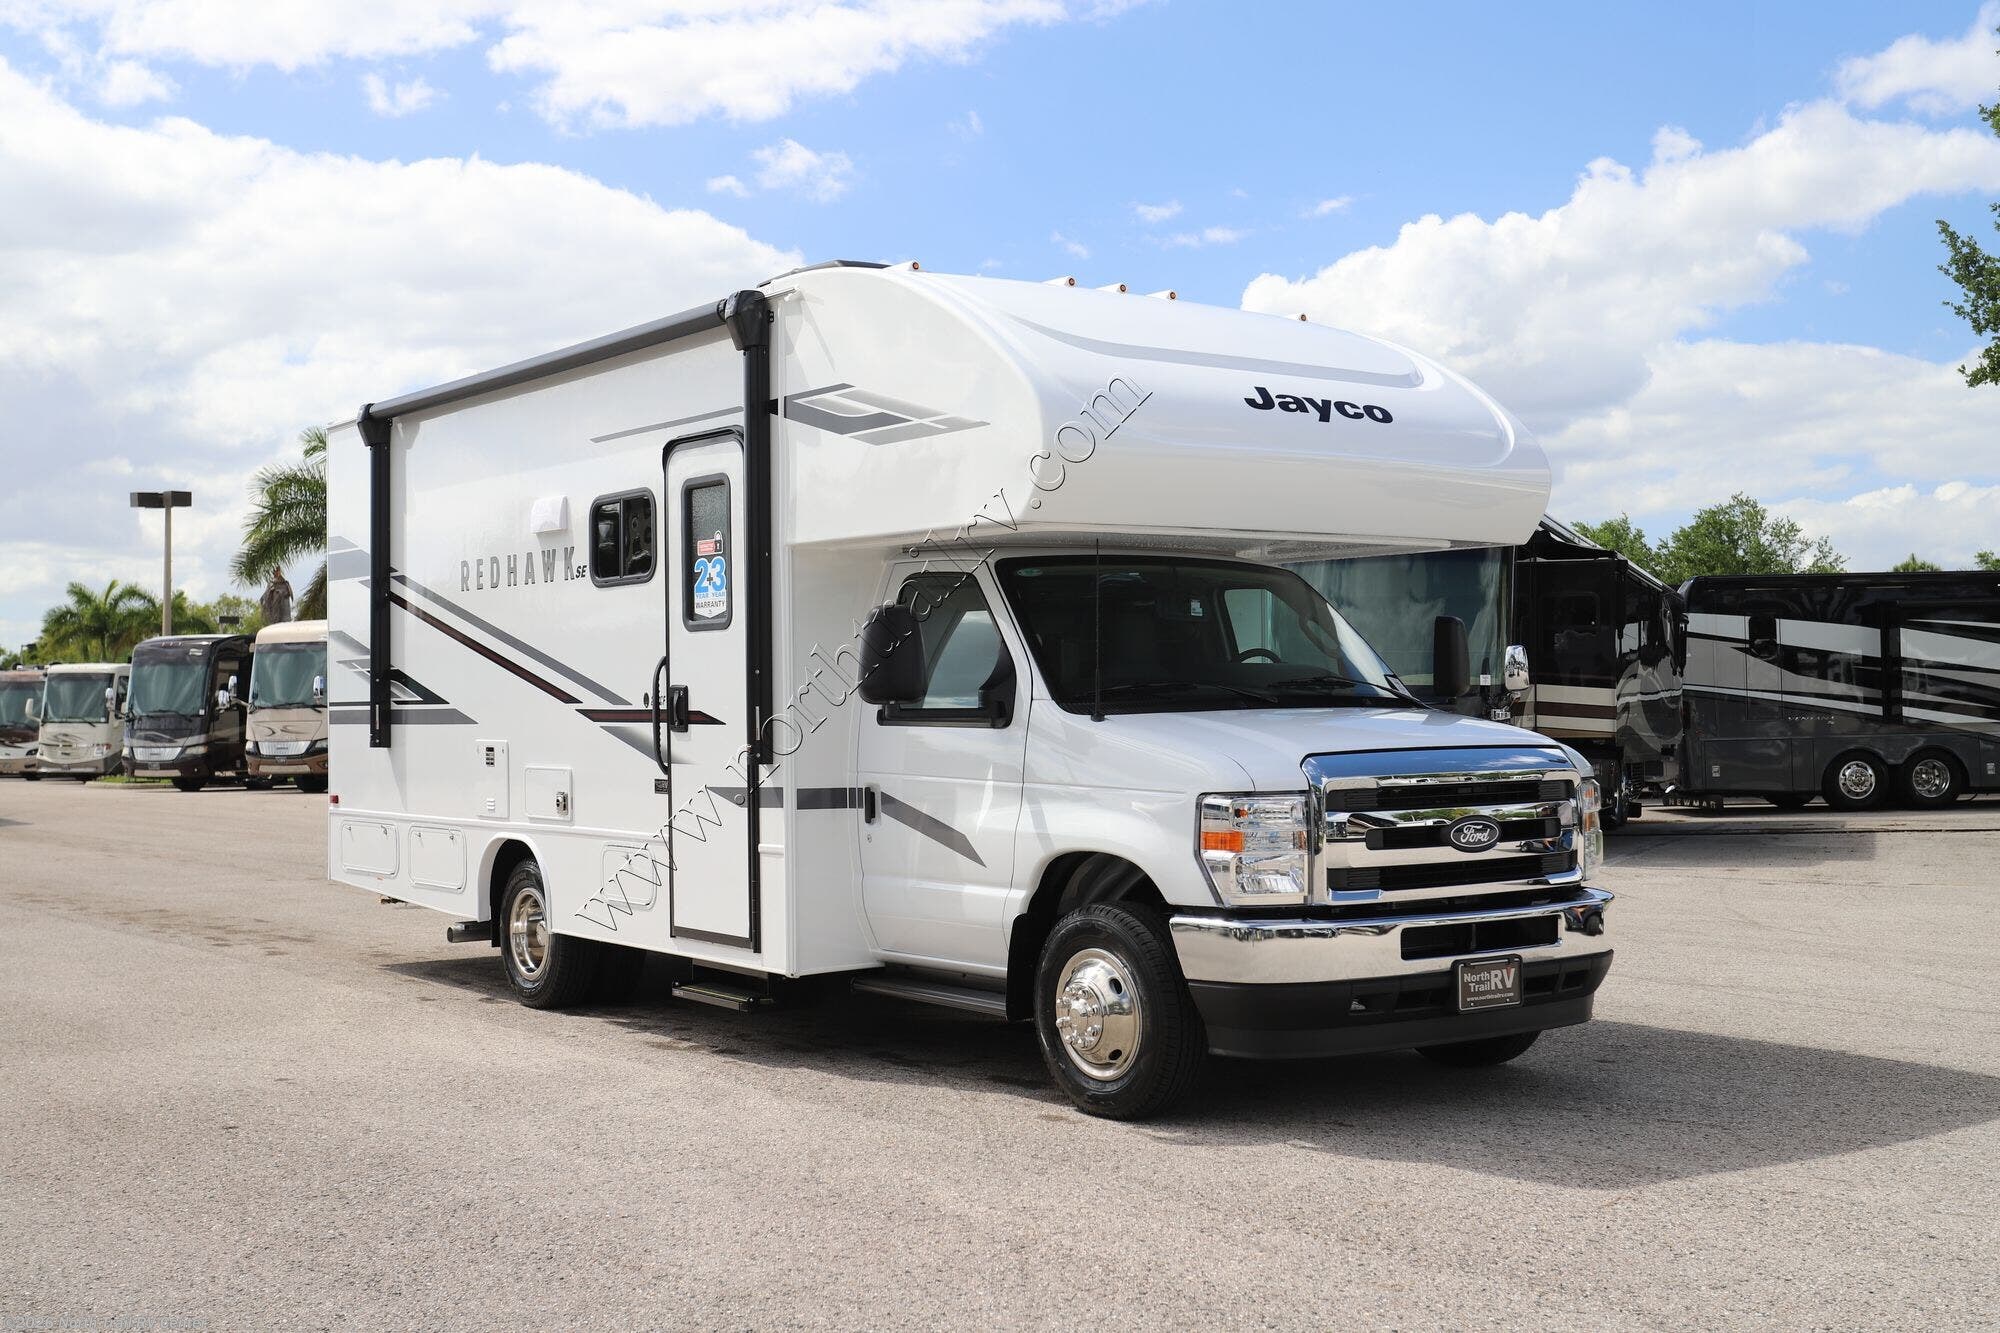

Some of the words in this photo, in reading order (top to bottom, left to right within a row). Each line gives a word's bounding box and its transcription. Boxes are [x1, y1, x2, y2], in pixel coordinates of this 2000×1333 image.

[1244, 386, 1394, 424] Jayco
[460, 546, 575, 592] REDHAWK
[575, 565, 587, 578] SE
[695, 600, 725, 609] WARRANTY
[1460, 824, 1490, 843] Ford
[1463, 971, 1490, 983] North
[1490, 967, 1516, 990] RV
[1469, 981, 1490, 992] Trail
